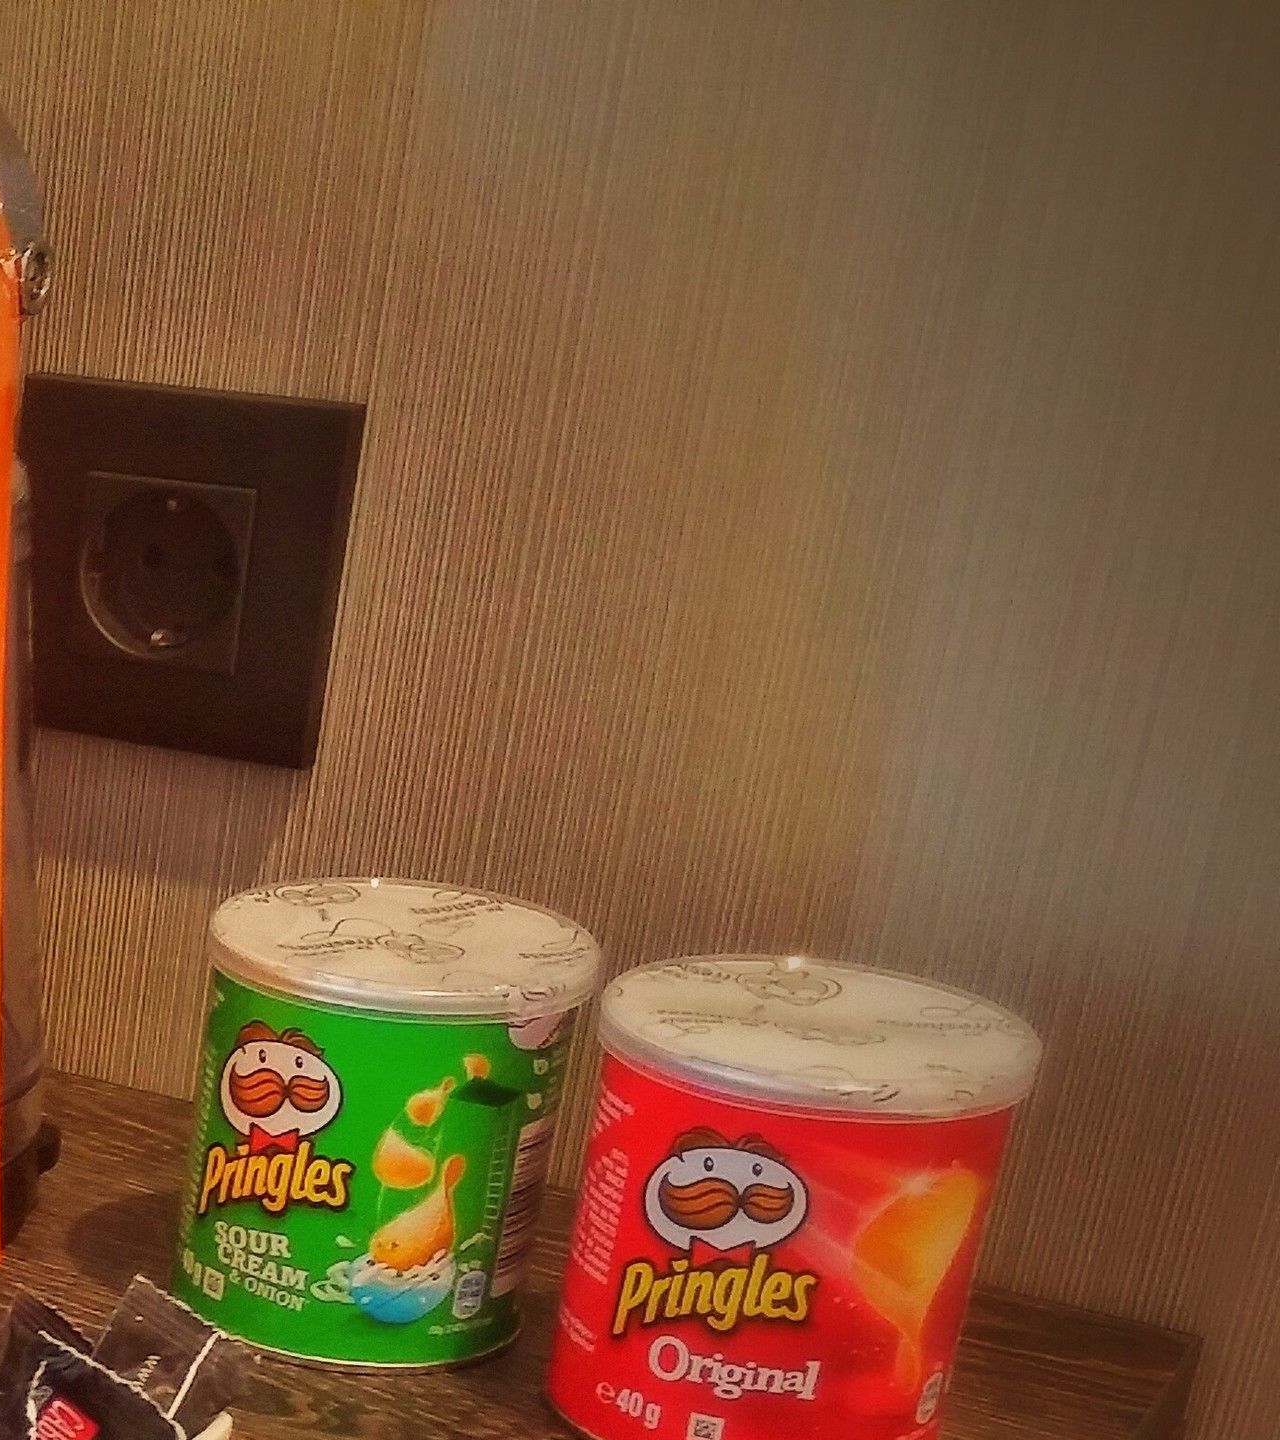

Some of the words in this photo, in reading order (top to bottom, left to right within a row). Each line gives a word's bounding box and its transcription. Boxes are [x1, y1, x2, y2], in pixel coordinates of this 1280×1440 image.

[198, 1141, 352, 1214] Pringles
[215, 1221, 291, 1258] SOUR
[218, 1242, 309, 1290] CREAM
[244, 1277, 306, 1311] ONION
[613, 1254, 817, 1334] Pringles
[648, 1336, 821, 1400] Original
